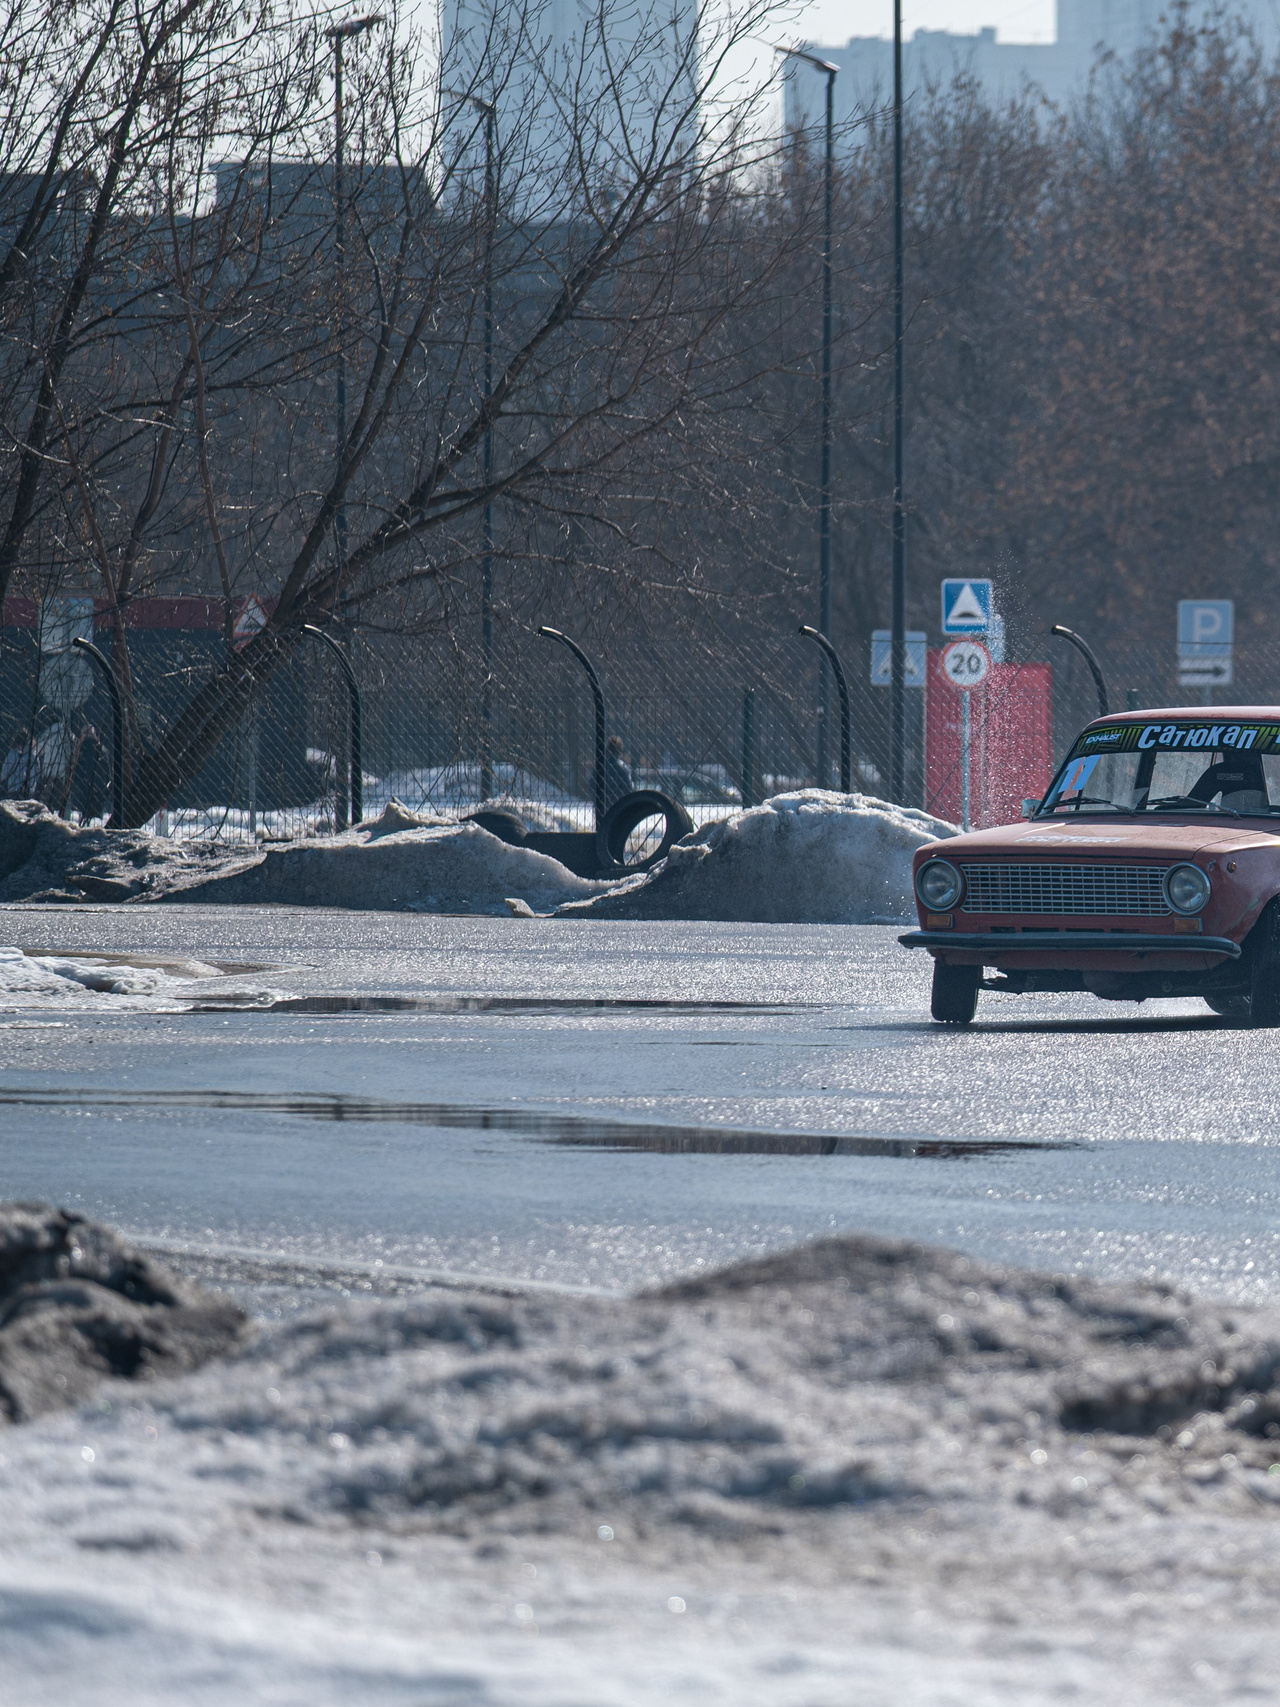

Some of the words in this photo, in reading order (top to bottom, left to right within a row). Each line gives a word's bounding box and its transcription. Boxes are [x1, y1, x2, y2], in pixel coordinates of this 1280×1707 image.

[1193, 607, 1223, 652] P
[951, 653, 981, 675] 20
[1085, 733, 1122, 744] EXHAUST
[1058, 754, 1101, 793] 11
